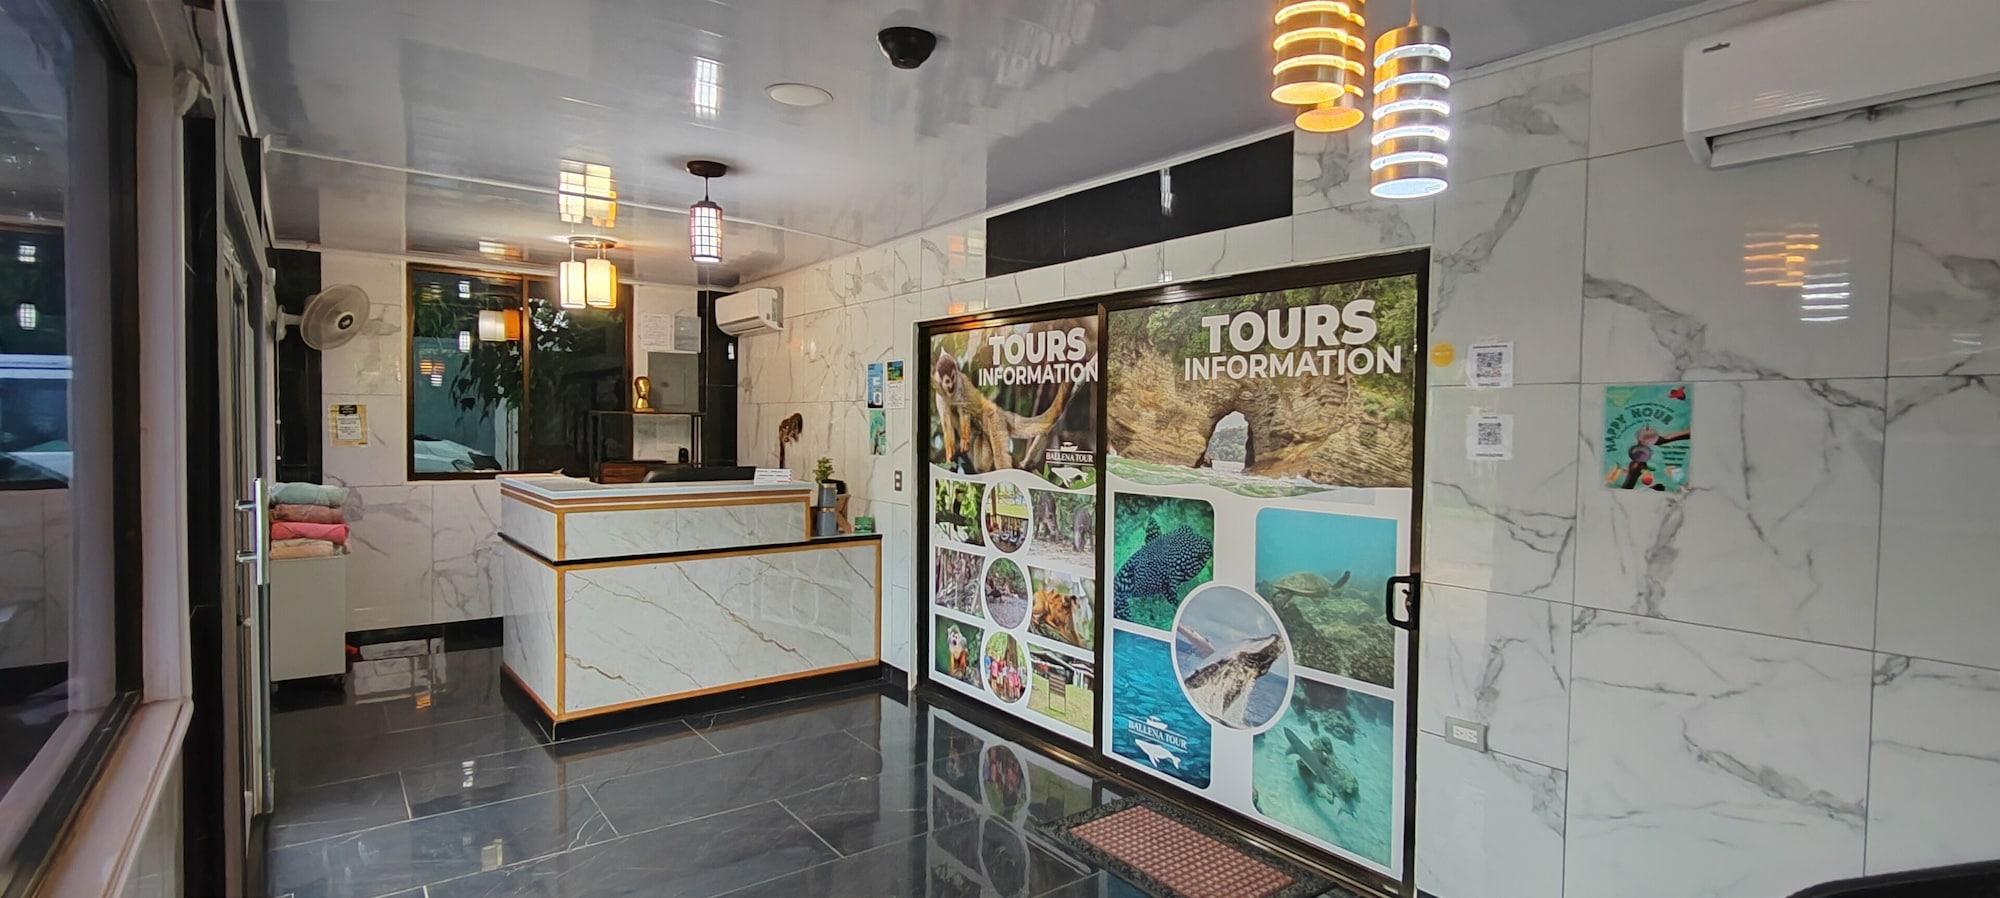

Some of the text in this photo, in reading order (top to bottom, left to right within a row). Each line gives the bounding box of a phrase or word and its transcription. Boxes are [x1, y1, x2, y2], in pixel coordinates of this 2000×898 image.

[1201, 299, 1378, 354] TOURS
[988, 327, 1088, 366] TOURS
[1184, 345, 1403, 382] INFORMATION
[978, 362, 1099, 387] INFORMATION
[1604, 407, 1674, 453] HAPPY HOUR
[1045, 451, 1094, 463] BALLENA TOUR
[1128, 720, 1188, 749] BALLENA TOUR
